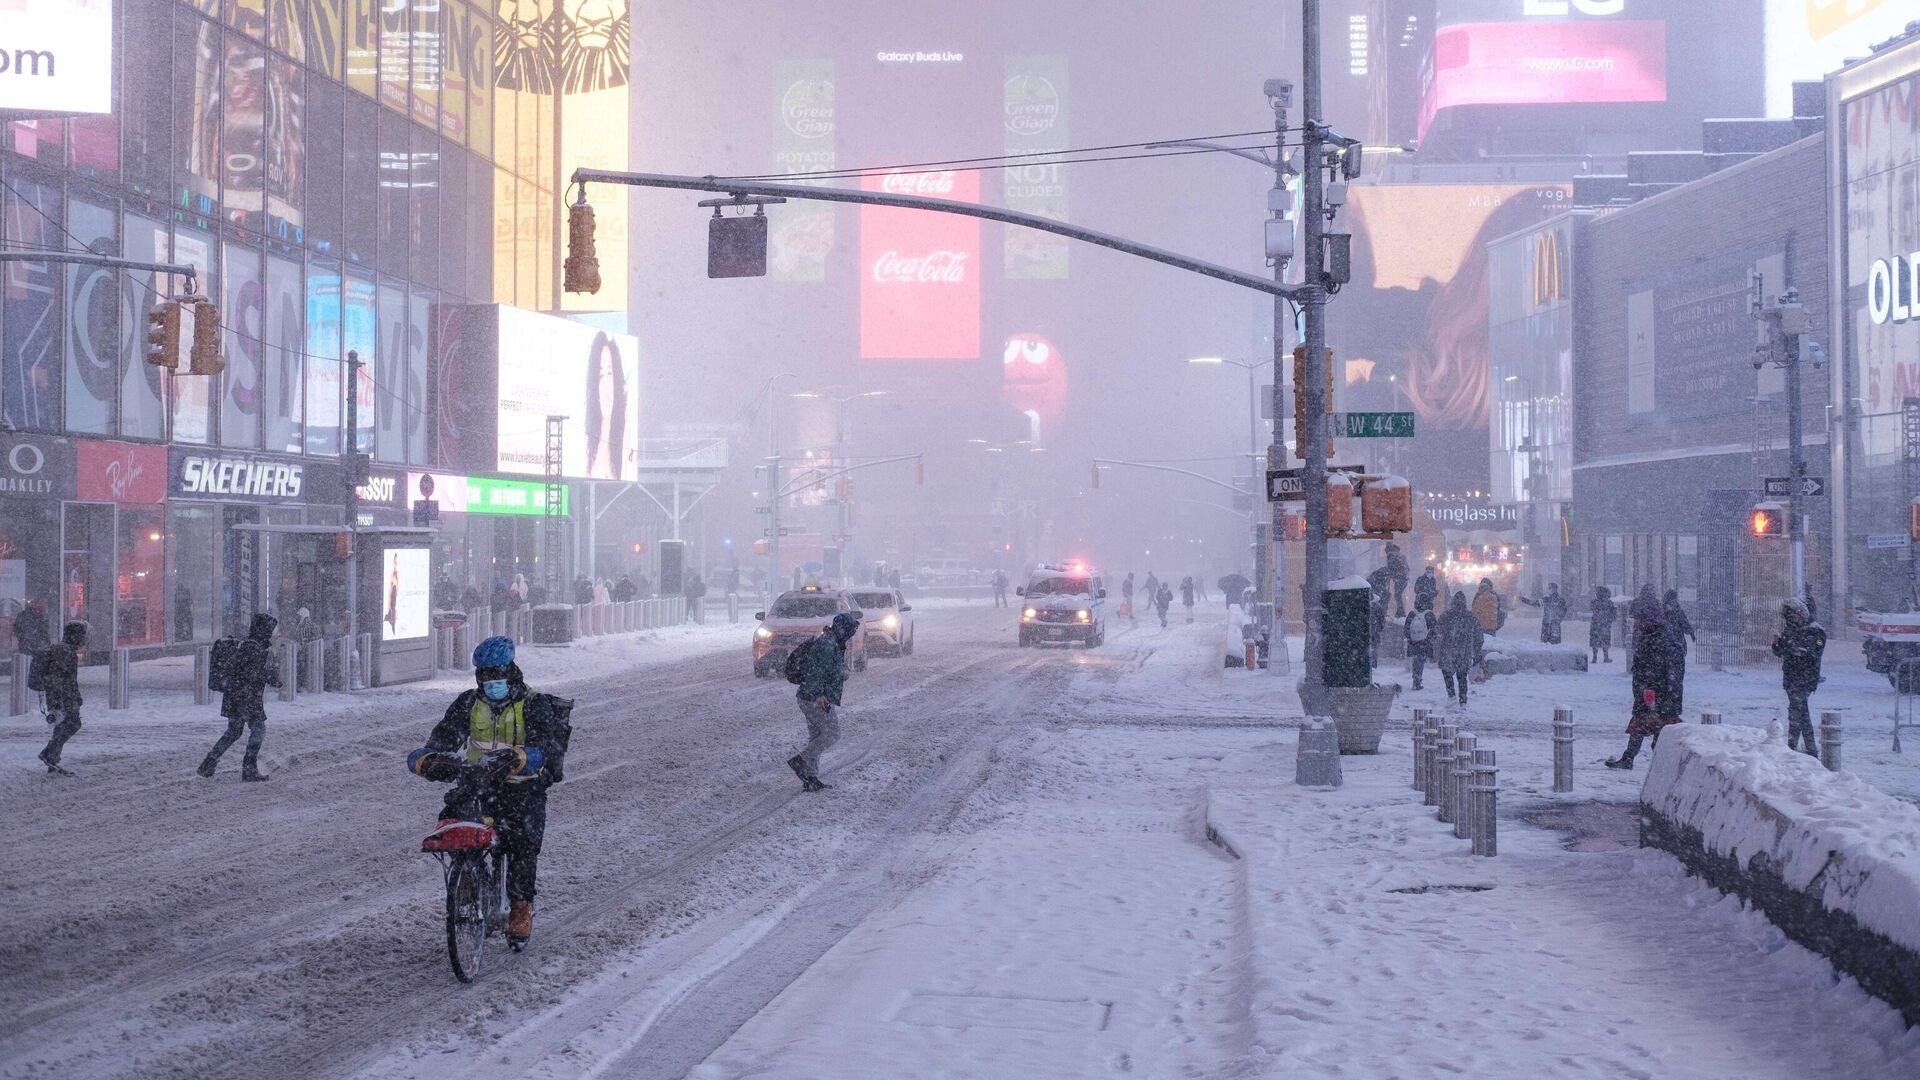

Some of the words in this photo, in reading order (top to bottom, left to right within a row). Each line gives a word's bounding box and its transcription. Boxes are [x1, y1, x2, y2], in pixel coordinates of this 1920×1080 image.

[877, 51, 915, 63] Galaxy
[916, 51, 942, 61] Buds
[943, 51, 963, 61] Live
[1529, 57, 1615, 71] www.LG.com
[1004, 102, 1055, 115] Green
[1011, 115, 1055, 130] Giant
[1003, 163, 1063, 184] NOT
[1350, 416, 1365, 434] W
[1373, 416, 1394, 434] 44
[182, 456, 303, 497] SKECHERS
[0, 477, 53, 493] OAKLEY
[1801, 482, 1815, 491] AY
[1427, 503, 1497, 525] unglass
